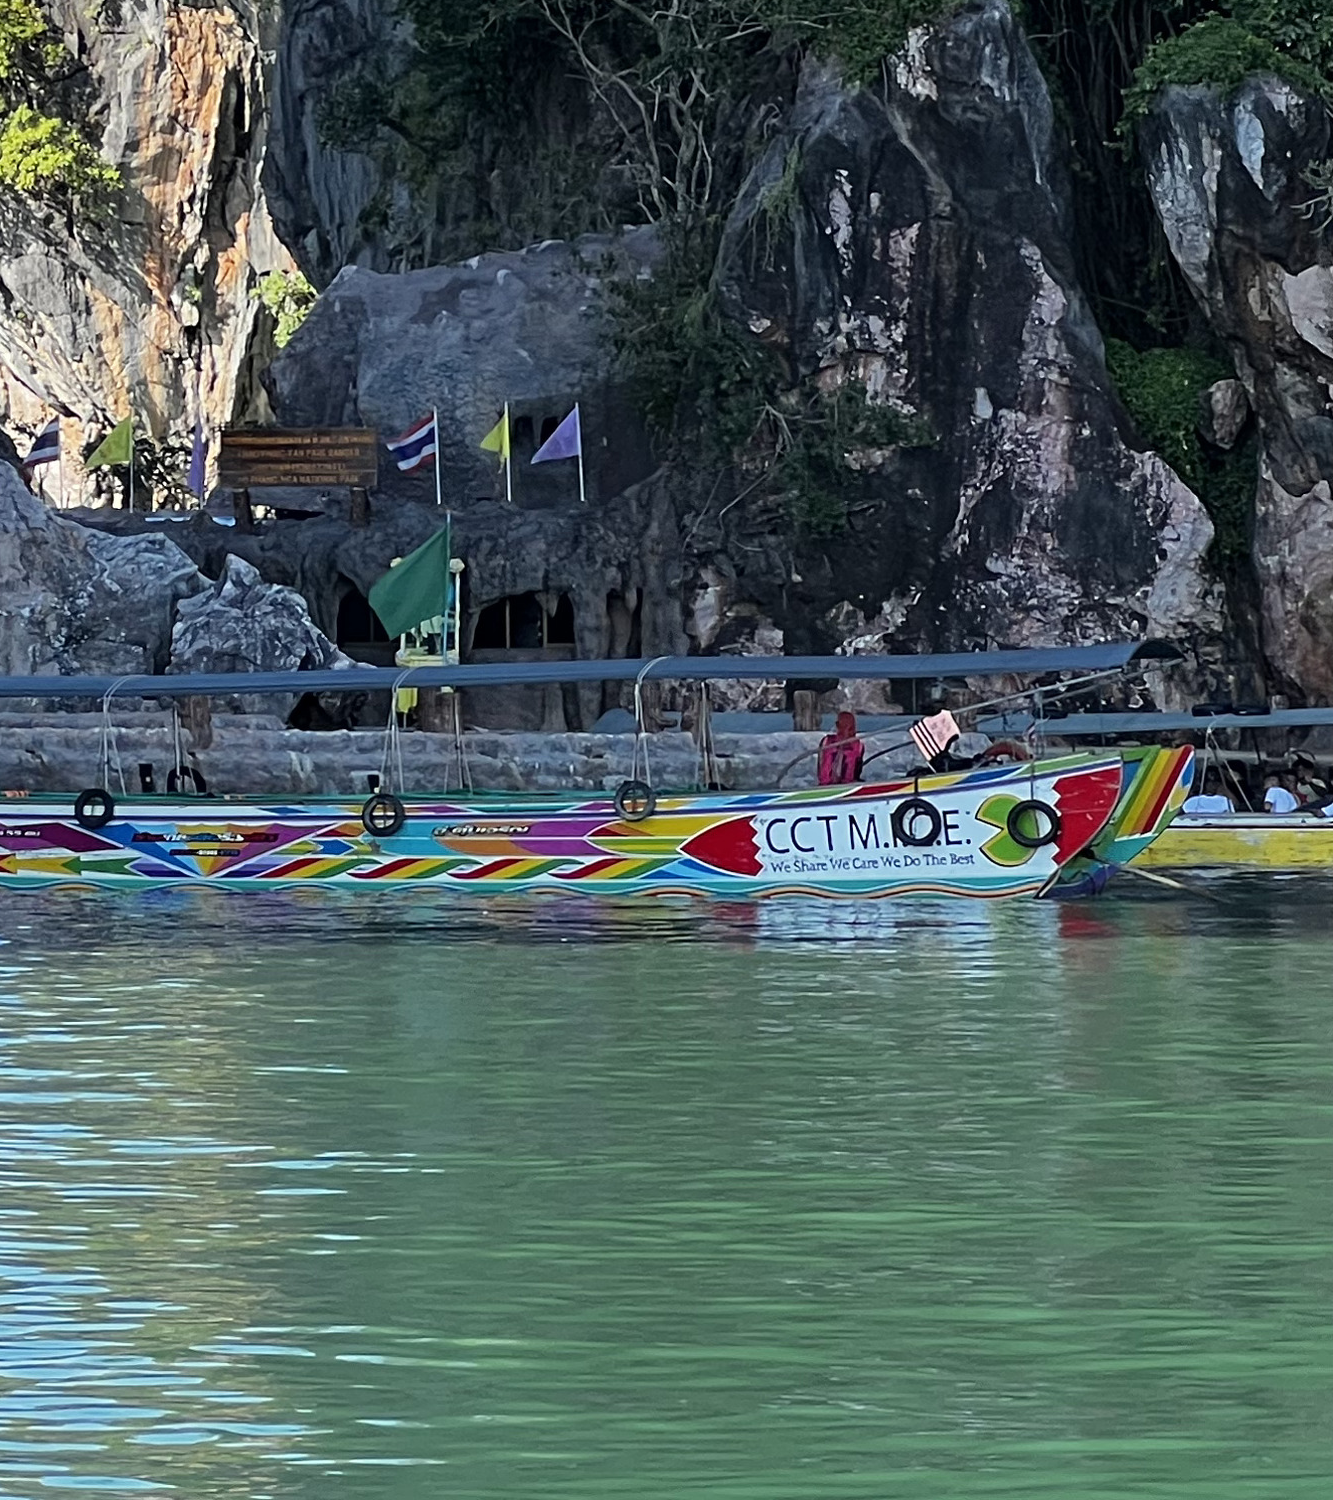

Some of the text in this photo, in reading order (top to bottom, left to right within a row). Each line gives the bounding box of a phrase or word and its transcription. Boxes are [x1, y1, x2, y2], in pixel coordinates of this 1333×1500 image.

[765, 815, 838, 854] CCT
[771, 852, 975, 873] We Share We Care We Do The Best
